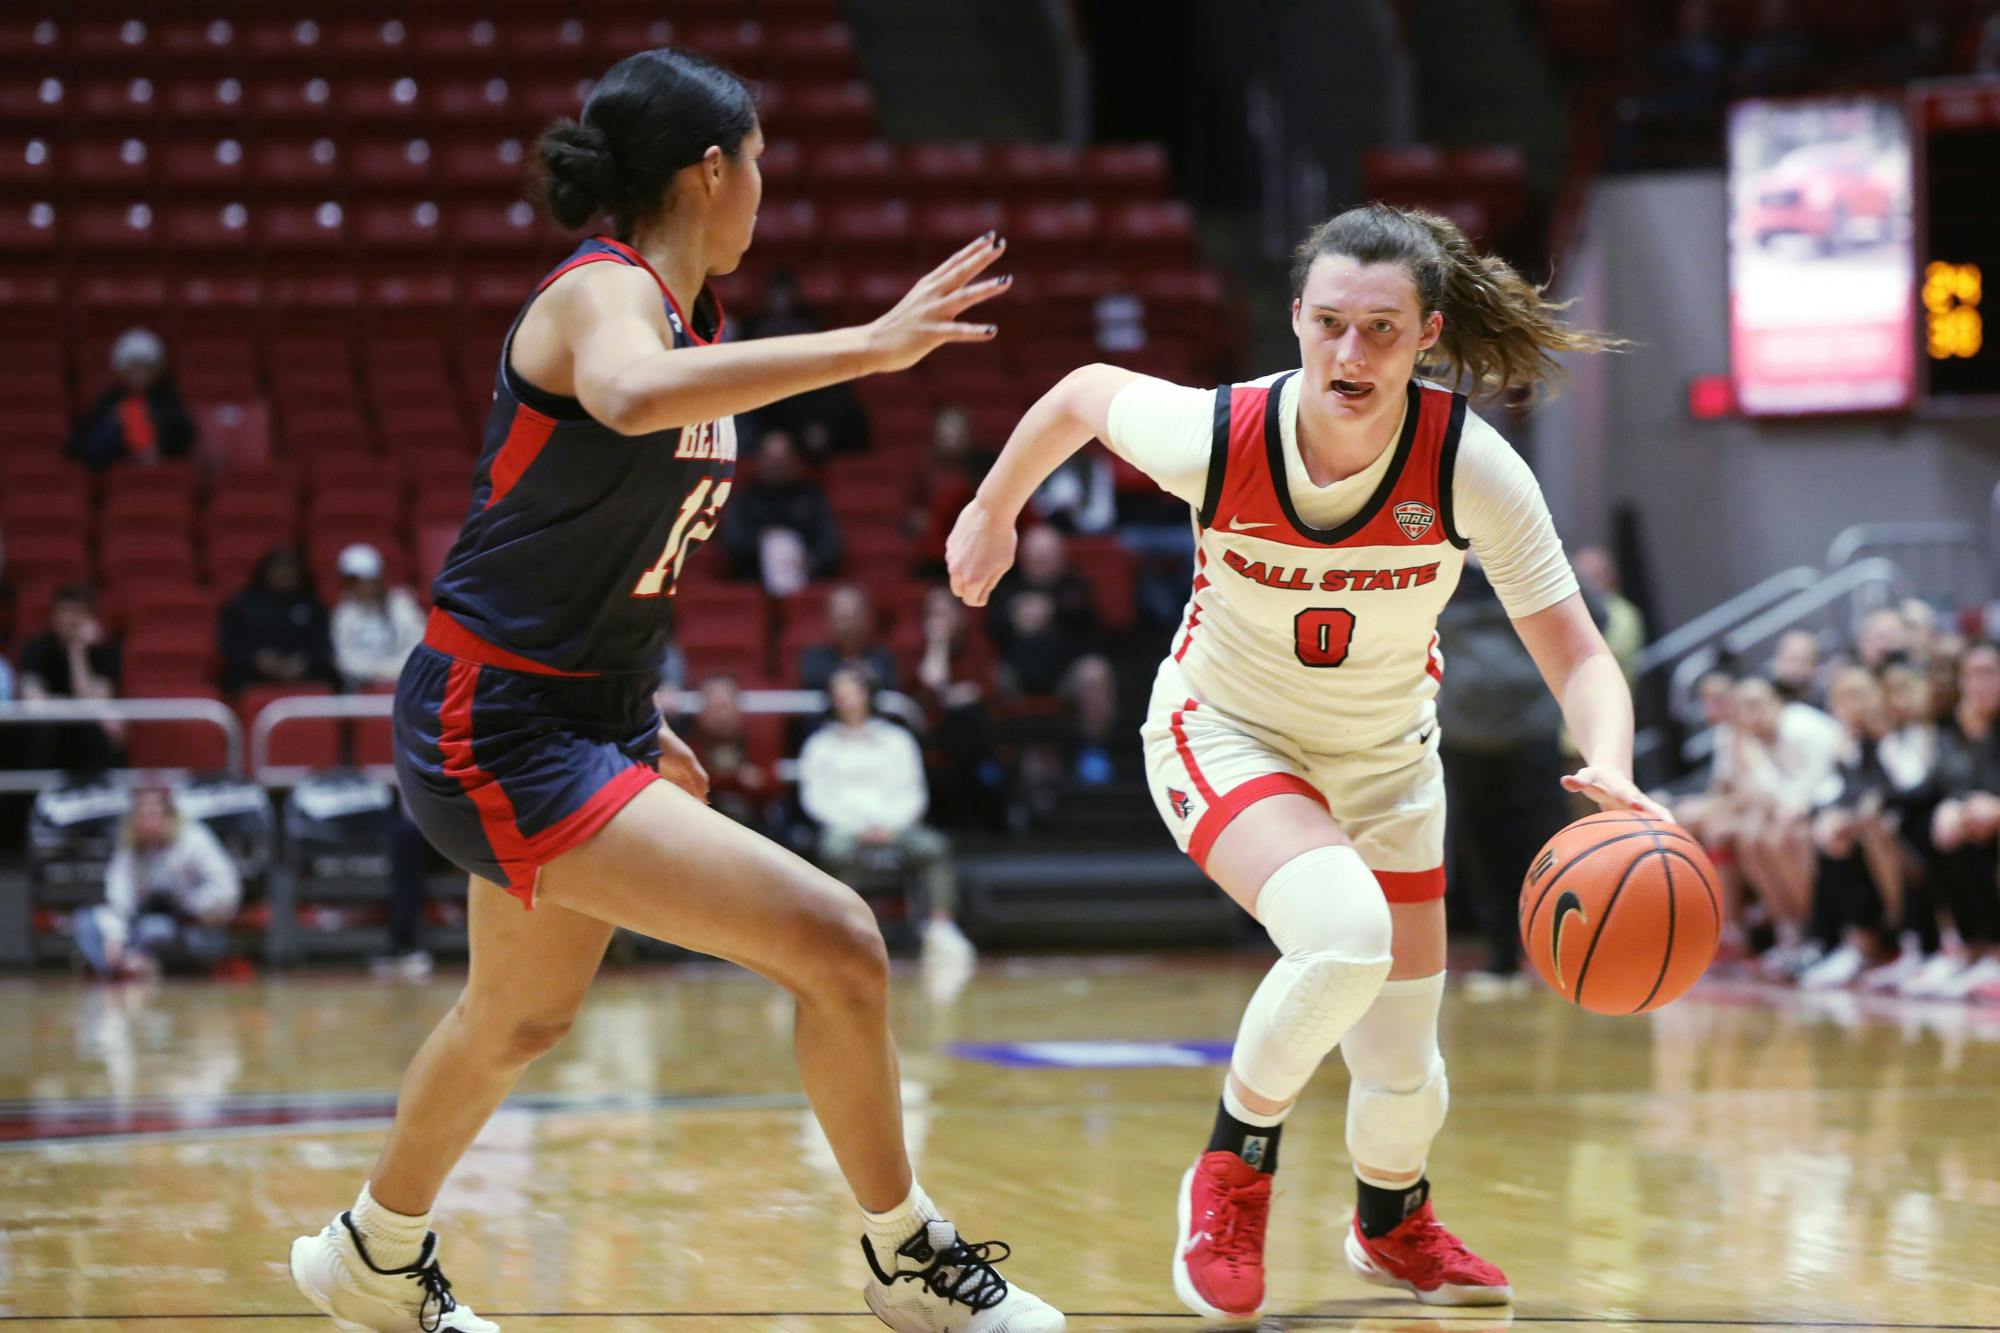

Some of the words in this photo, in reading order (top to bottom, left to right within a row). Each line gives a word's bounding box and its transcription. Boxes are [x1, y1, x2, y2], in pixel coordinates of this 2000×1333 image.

[1397, 513, 1432, 526] MAC
[1222, 549, 1314, 591] BALL
[1319, 561, 1441, 592] STATE
[1293, 607, 1356, 668] 0
